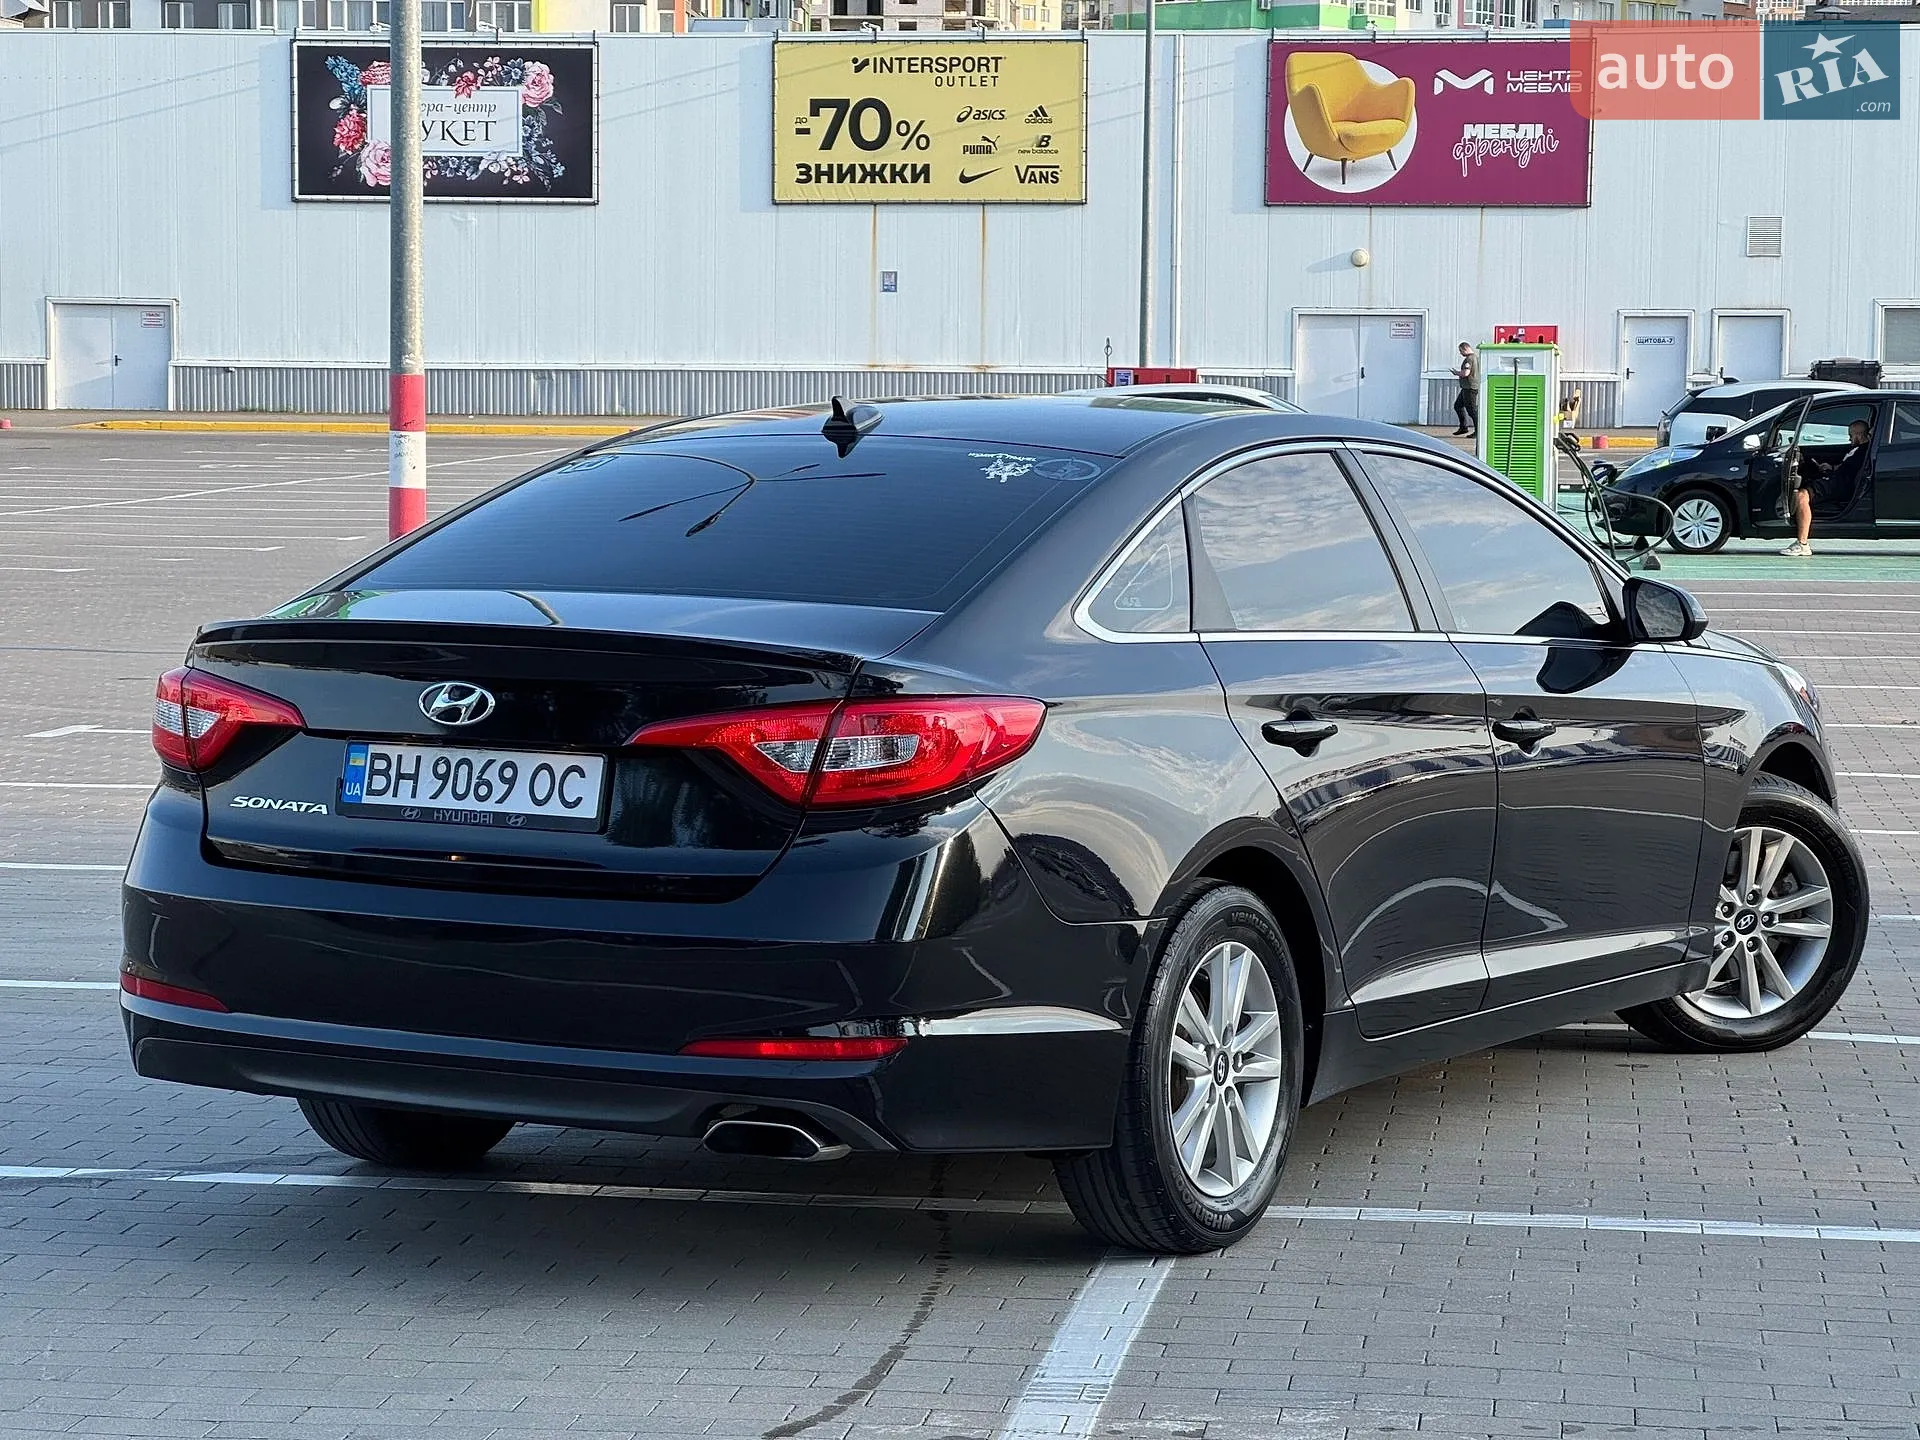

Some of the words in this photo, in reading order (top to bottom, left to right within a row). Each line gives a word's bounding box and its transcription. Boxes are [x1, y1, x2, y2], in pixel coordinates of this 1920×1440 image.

[873, 56, 1003, 73] INTERSPORT
[934, 75, 999, 88] OUTLET
[1506, 70, 1583, 82] ЦЕНТР
[421, 103, 497, 117] ора-центр
[421, 120, 497, 147] УКЕТ
[795, 162, 931, 184] ЗНИЖКИ
[1014, 164, 1060, 184] VANS
[345, 782, 361, 796] UA
[365, 752, 422, 800] BH
[428, 756, 519, 805] 9069
[528, 762, 587, 809] OC
[229, 796, 329, 815] SONATA
[433, 810, 494, 825] HYUNDAI
